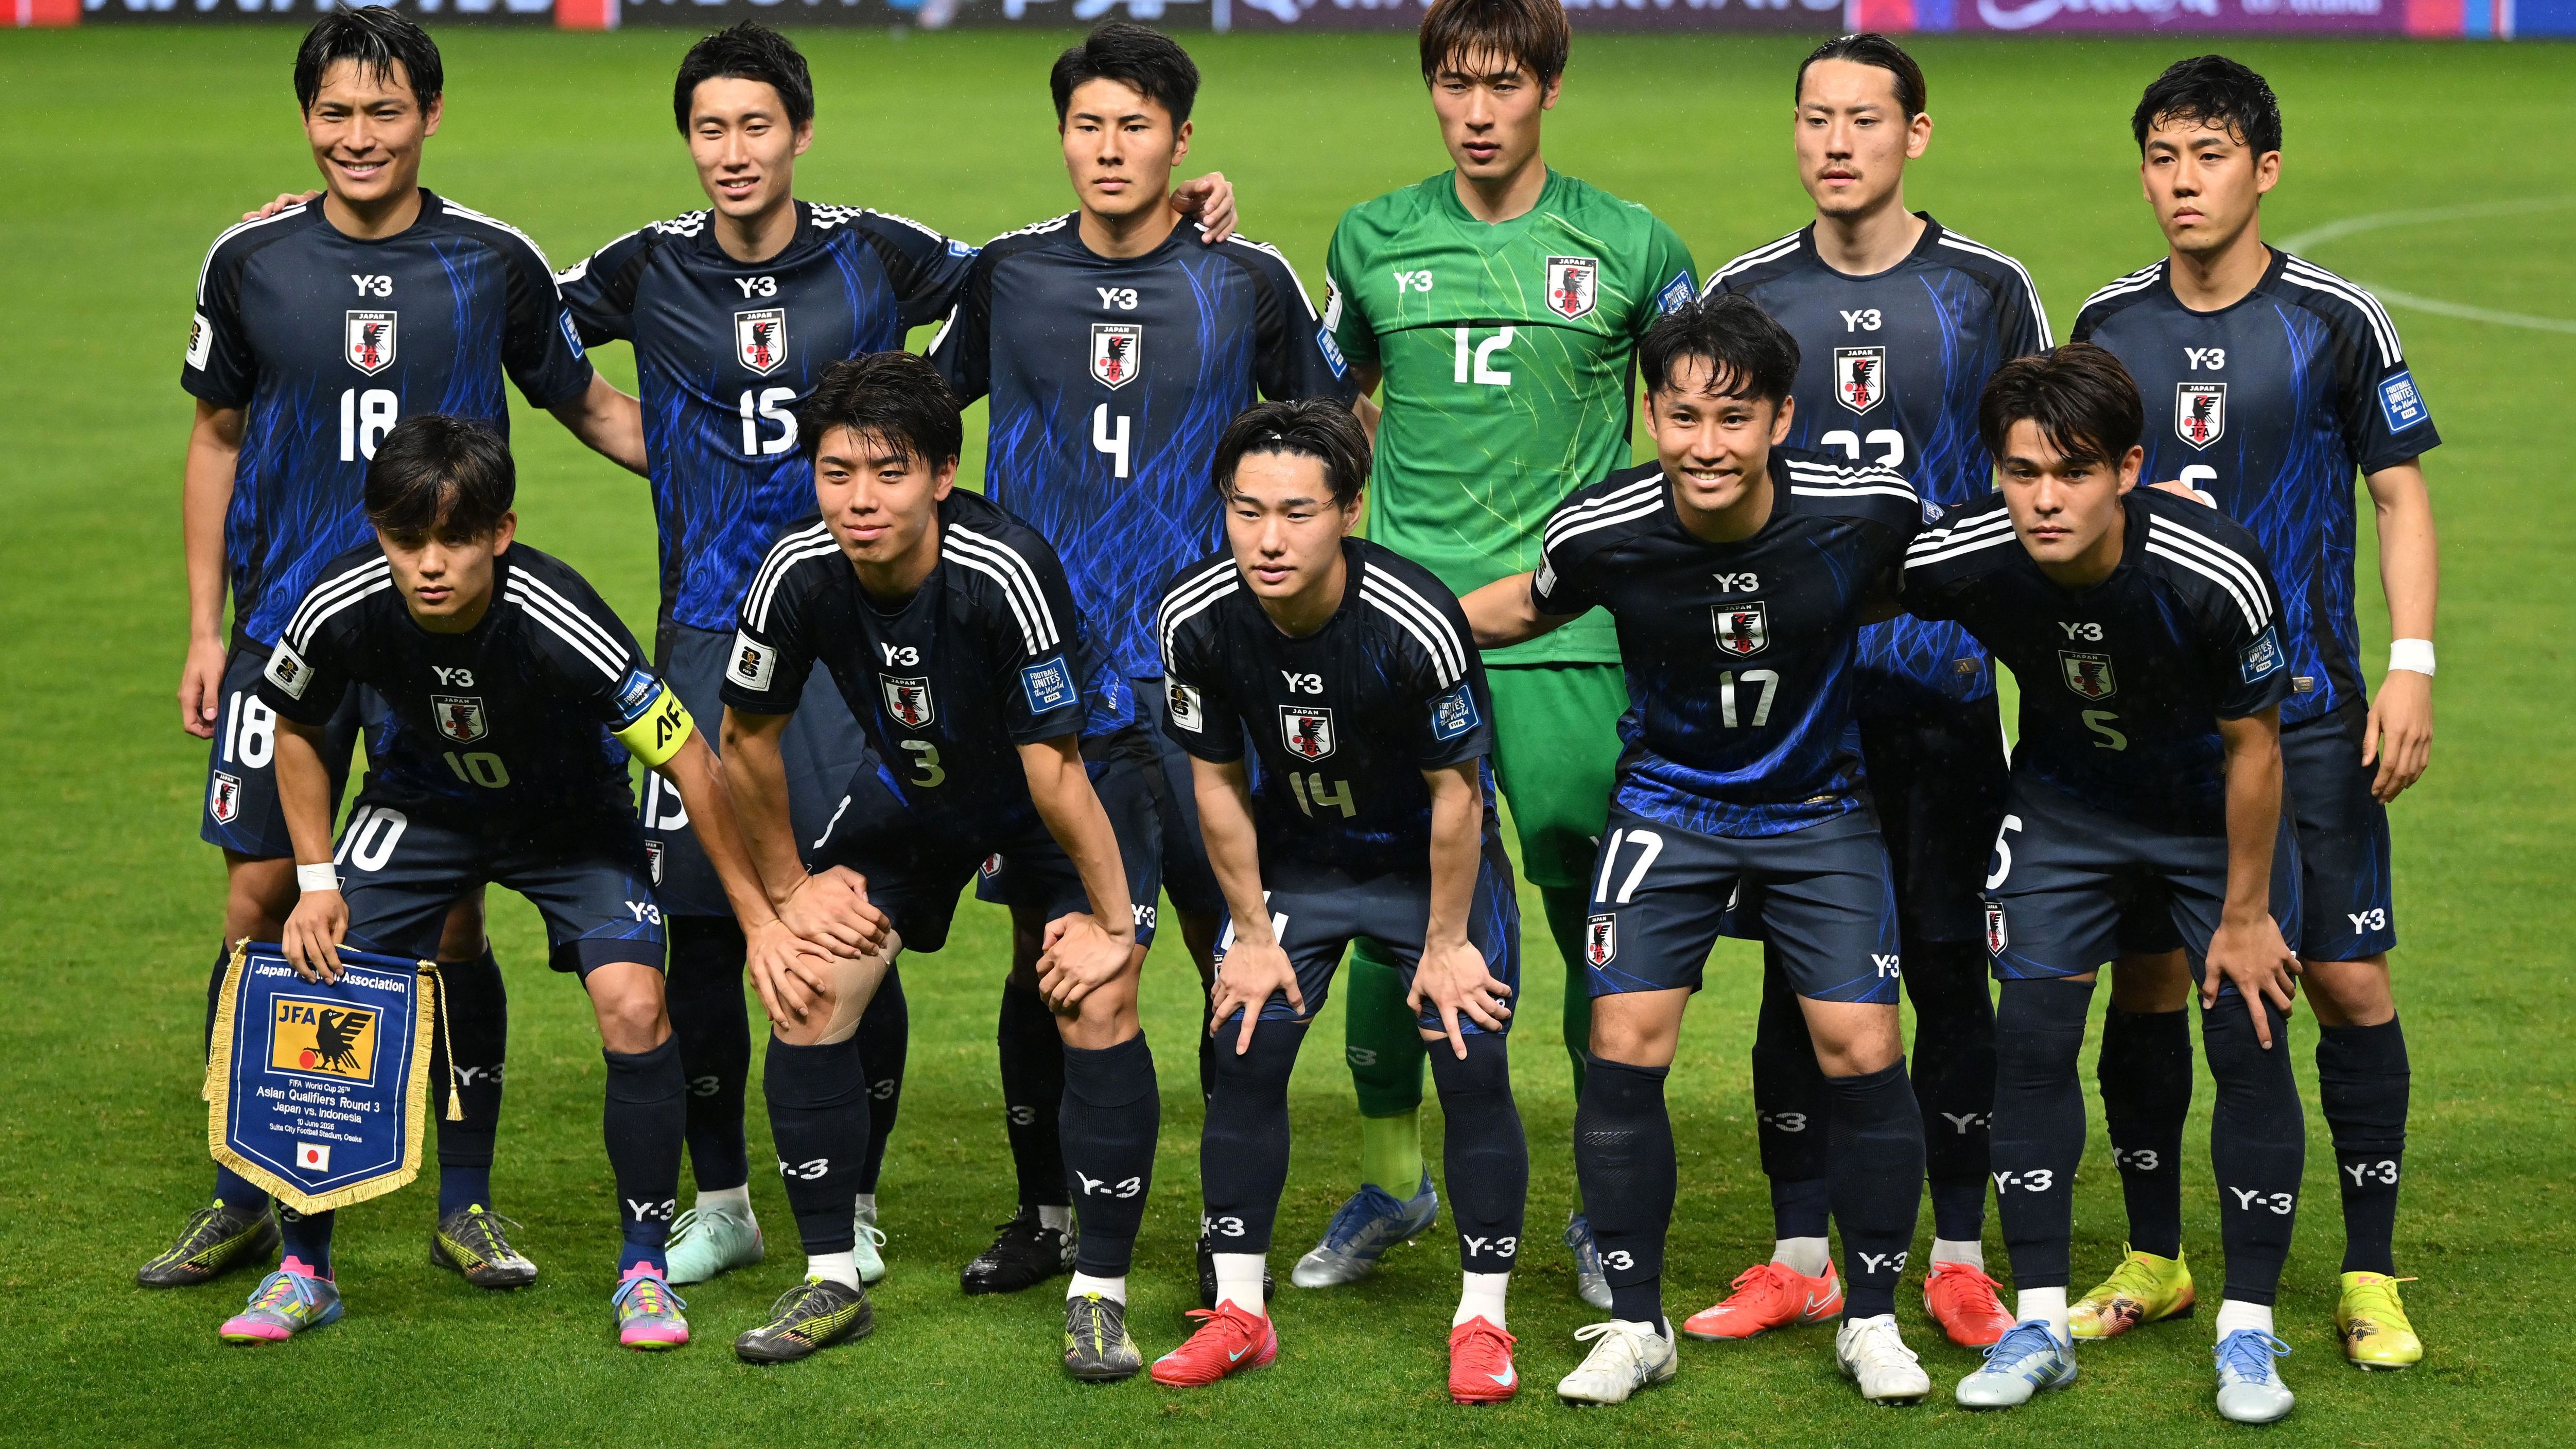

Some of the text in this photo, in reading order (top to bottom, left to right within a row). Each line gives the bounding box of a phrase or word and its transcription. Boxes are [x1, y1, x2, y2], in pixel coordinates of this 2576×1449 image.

[351, 275, 392, 297] Y-3
[735, 276, 777, 298] Y-3
[1393, 270, 1433, 293] Y-3
[1664, 281, 1686, 301] FOOTBALL
[1096, 287, 1137, 310] Y-3
[1559, 299, 1581, 310] JFA
[746, 311, 772, 320] JAPAN
[1840, 309, 1881, 332] Y-3
[360, 354, 381, 363] JFA
[752, 354, 773, 364] JFA
[1454, 319, 1513, 386] 12
[2184, 347, 2225, 370] Y-3
[1105, 368, 1124, 378] JFA
[1850, 391, 1871, 402] JFA
[2385, 379, 2410, 395] FOOTBALL
[2388, 386, 2414, 404] UNITES
[2391, 395, 2417, 413] the World
[340, 389, 398, 461] 18
[739, 387, 799, 456] 15
[2189, 427, 2210, 438] JFA
[1093, 403, 1129, 478] 4
[1713, 573, 1759, 592] Y-3
[2059, 622, 2103, 641] Y-3
[881, 642, 919, 666] Y-3
[1732, 640, 1754, 649] JFA
[431, 666, 474, 687] Y-3
[1030, 667, 1058, 680] FOOTBALL
[1032, 673, 1060, 689] UNITES
[1281, 671, 1324, 694] Y-3
[623, 680, 644, 704] FOOTBALL
[1046, 680, 1064, 694] World
[1720, 670, 1779, 727] 17
[901, 711, 920, 722] JFA
[1450, 707, 1469, 720] World
[223, 691, 276, 769] 18
[2081, 710, 2128, 752] 5
[1298, 744, 1319, 753] JFA
[443, 752, 510, 789] 10
[900, 740, 945, 788] 3
[1289, 772, 1356, 818] 14
[217, 807, 229, 816] JFA
[334, 805, 407, 871] 10
[1986, 814, 2022, 889] 5
[1595, 828, 1663, 903] 17
[625, 901, 661, 924] Y-3
[1132, 904, 1155, 928] Y-3
[2348, 908, 2385, 934] Y-3
[1592, 950, 1606, 960] JFA
[1871, 954, 1900, 978] Y-3
[255, 964, 291, 978] Japan
[342, 971, 405, 993] Association
[279, 1005, 316, 1025] JFA
[453, 1063, 503, 1086] Y-3
[289, 1079, 302, 1088] FIFA
[305, 1081, 323, 1091] World
[324, 1084, 336, 1093] Cup
[686, 1076, 719, 1096] -3
[866, 1079, 894, 1099] -3
[256, 1086, 380, 1112] Asian Qualifiers Round 3
[272, 1102, 362, 1124] Japan vs. Indonesia
[1757, 1110, 1806, 1132] -3
[269, 1123, 362, 1143] Suita City Football Stadium, Osaka
[304, 1119, 319, 1128] June
[320, 1121, 335, 1130] 2025
[1076, 1170, 1141, 1198] Y-3
[1993, 1169, 2052, 1194] Y-3
[2345, 1160, 2397, 1186] Y-3
[627, 1198, 676, 1221] Y-3
[2229, 1186, 2292, 1214] Y-3
[1464, 1234, 1517, 1259] Y-3
[1598, 1250, 1634, 1272] -3
[1858, 1251, 1907, 1274] Y-3
